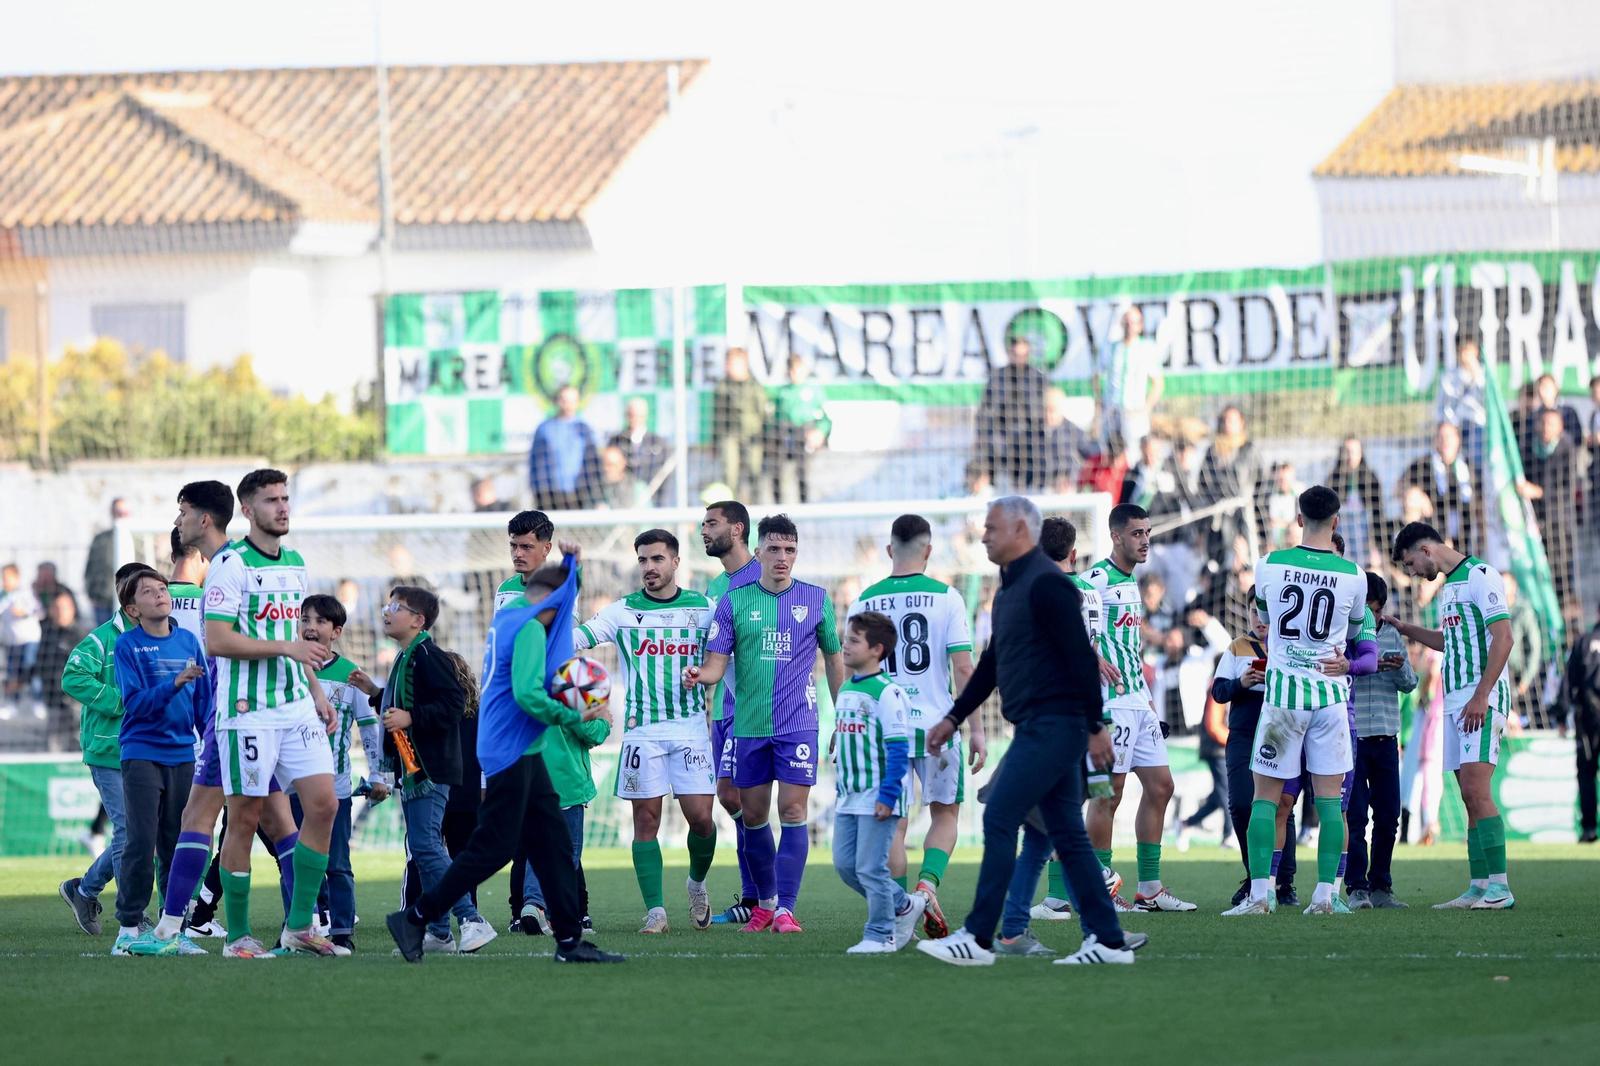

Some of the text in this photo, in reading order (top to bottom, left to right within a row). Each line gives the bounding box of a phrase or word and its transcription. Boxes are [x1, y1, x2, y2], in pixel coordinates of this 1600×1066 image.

[745, 307, 998, 377] MAREA
[398, 351, 514, 391] MAREA
[865, 595, 934, 612] ALEX GUTI
[1277, 584, 1336, 642] 20
[634, 638, 699, 656] Solear
[244, 735, 259, 763] 5
[1113, 724, 1131, 748] 22
[623, 744, 641, 770] 16
